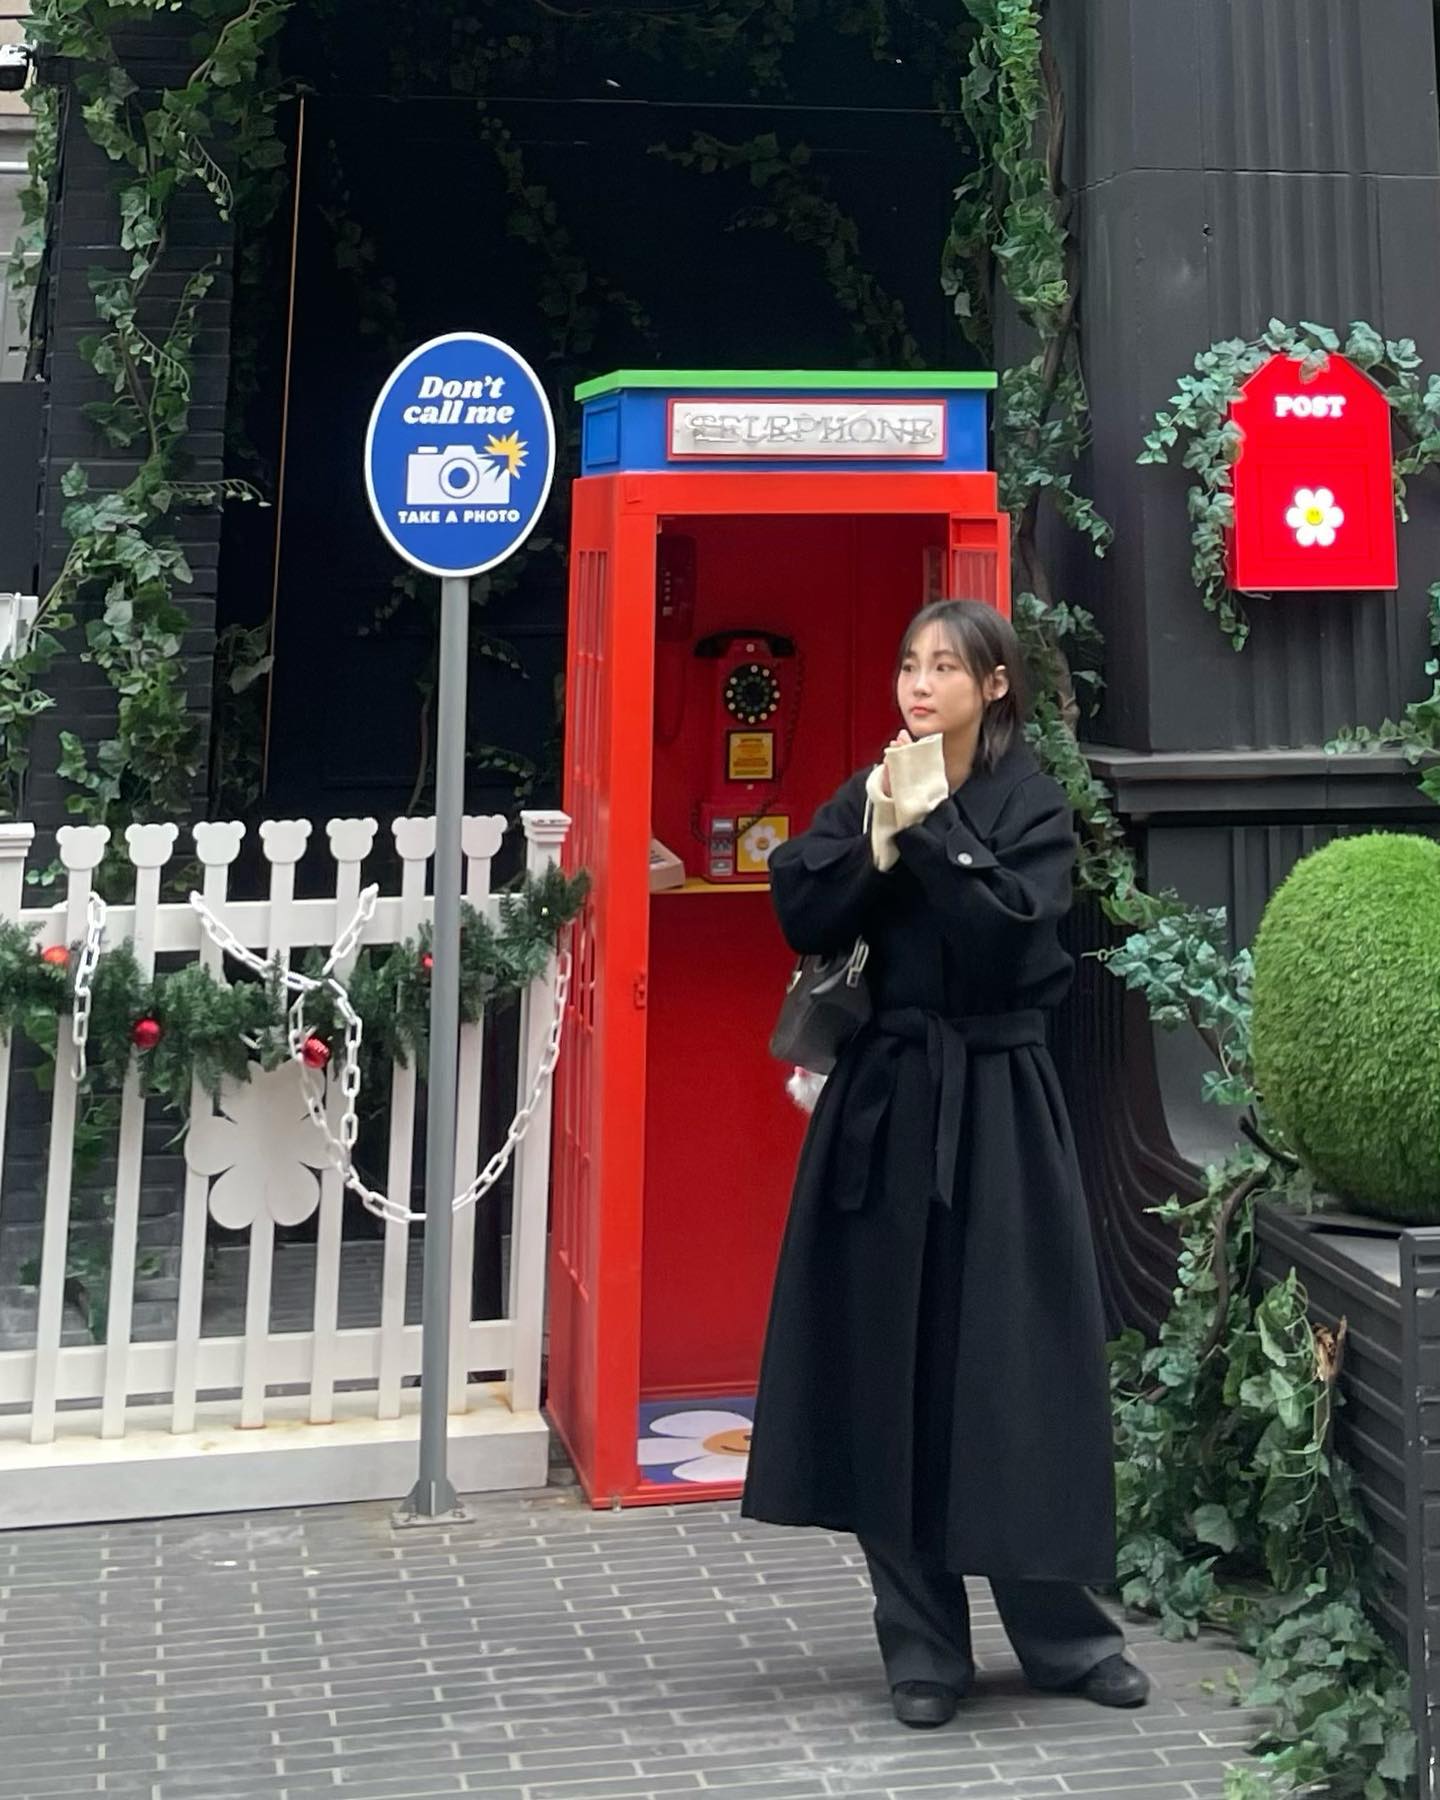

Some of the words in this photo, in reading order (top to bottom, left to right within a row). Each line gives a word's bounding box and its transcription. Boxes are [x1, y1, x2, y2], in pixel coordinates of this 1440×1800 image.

[419, 376, 506, 399] Don't
[403, 400, 463, 424] call
[465, 405, 515, 424] me
[1275, 395, 1346, 418] POST
[398, 511, 440, 524] TAKE
[445, 511, 458, 523] A
[463, 509, 520, 523] PHOTO
